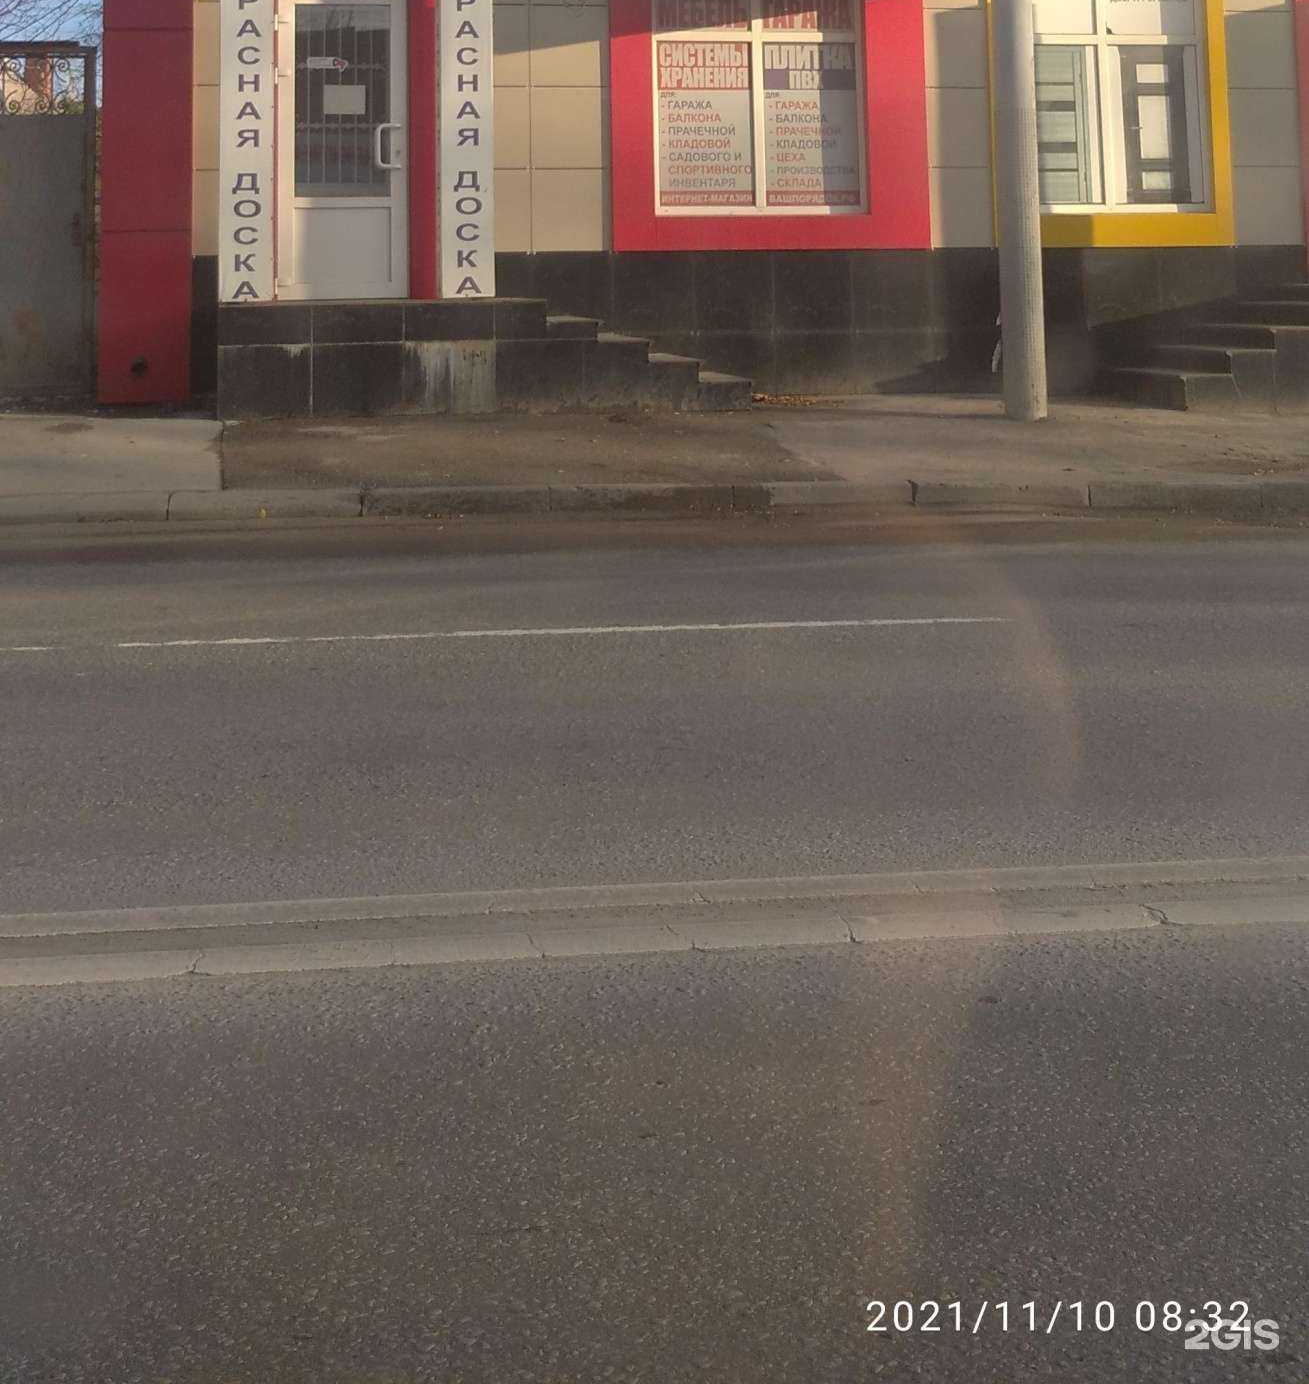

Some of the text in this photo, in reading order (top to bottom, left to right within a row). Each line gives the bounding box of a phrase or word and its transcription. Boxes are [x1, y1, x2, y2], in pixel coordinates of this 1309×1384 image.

[659, 43, 748, 67] СИСТЕМЫ
[660, 68, 748, 88] ХРАНЕНИЯ
[789, 70, 823, 89] ПВХ
[667, 101, 712, 110] ГАРАЖА
[668, 114, 722, 123] БАЛКОНА
[668, 138, 731, 150] КЛАДОВОЙ
[668, 153, 732, 163] САДОВОГО
[232, 172, 262, 299] ДОСКА
[453, 170, 482, 296] ДОСКА
